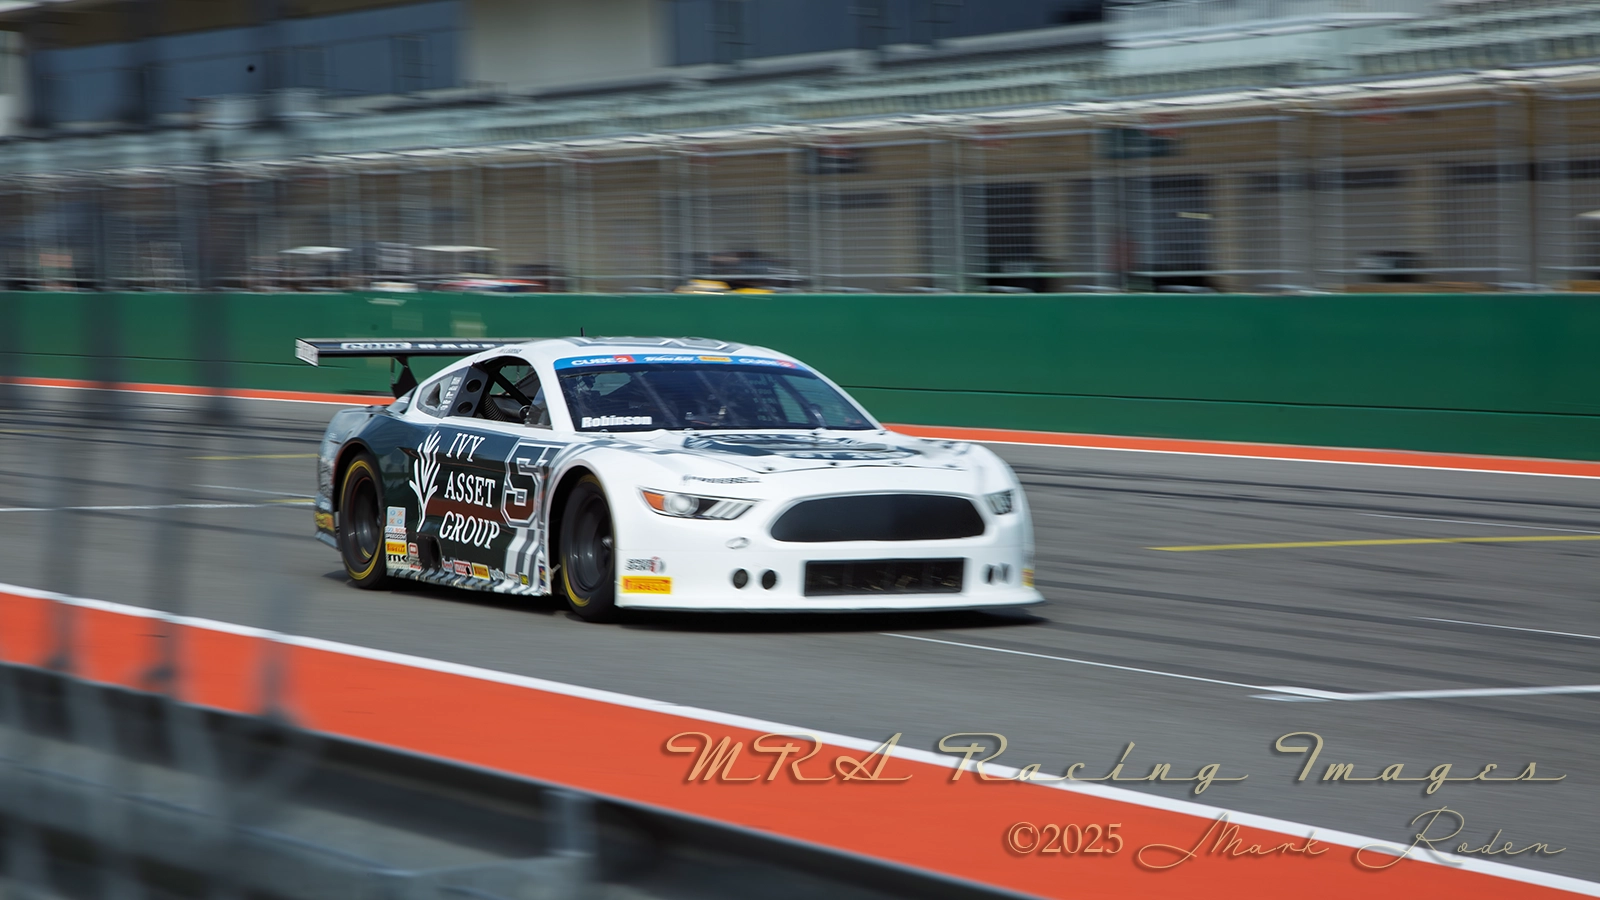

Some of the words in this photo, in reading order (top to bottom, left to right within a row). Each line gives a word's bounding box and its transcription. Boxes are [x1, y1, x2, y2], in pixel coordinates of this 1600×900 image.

[581, 414, 652, 428] Robinson
[446, 432, 485, 462] IVY
[444, 471, 496, 508] ASSET
[439, 511, 500, 549] GROUP
